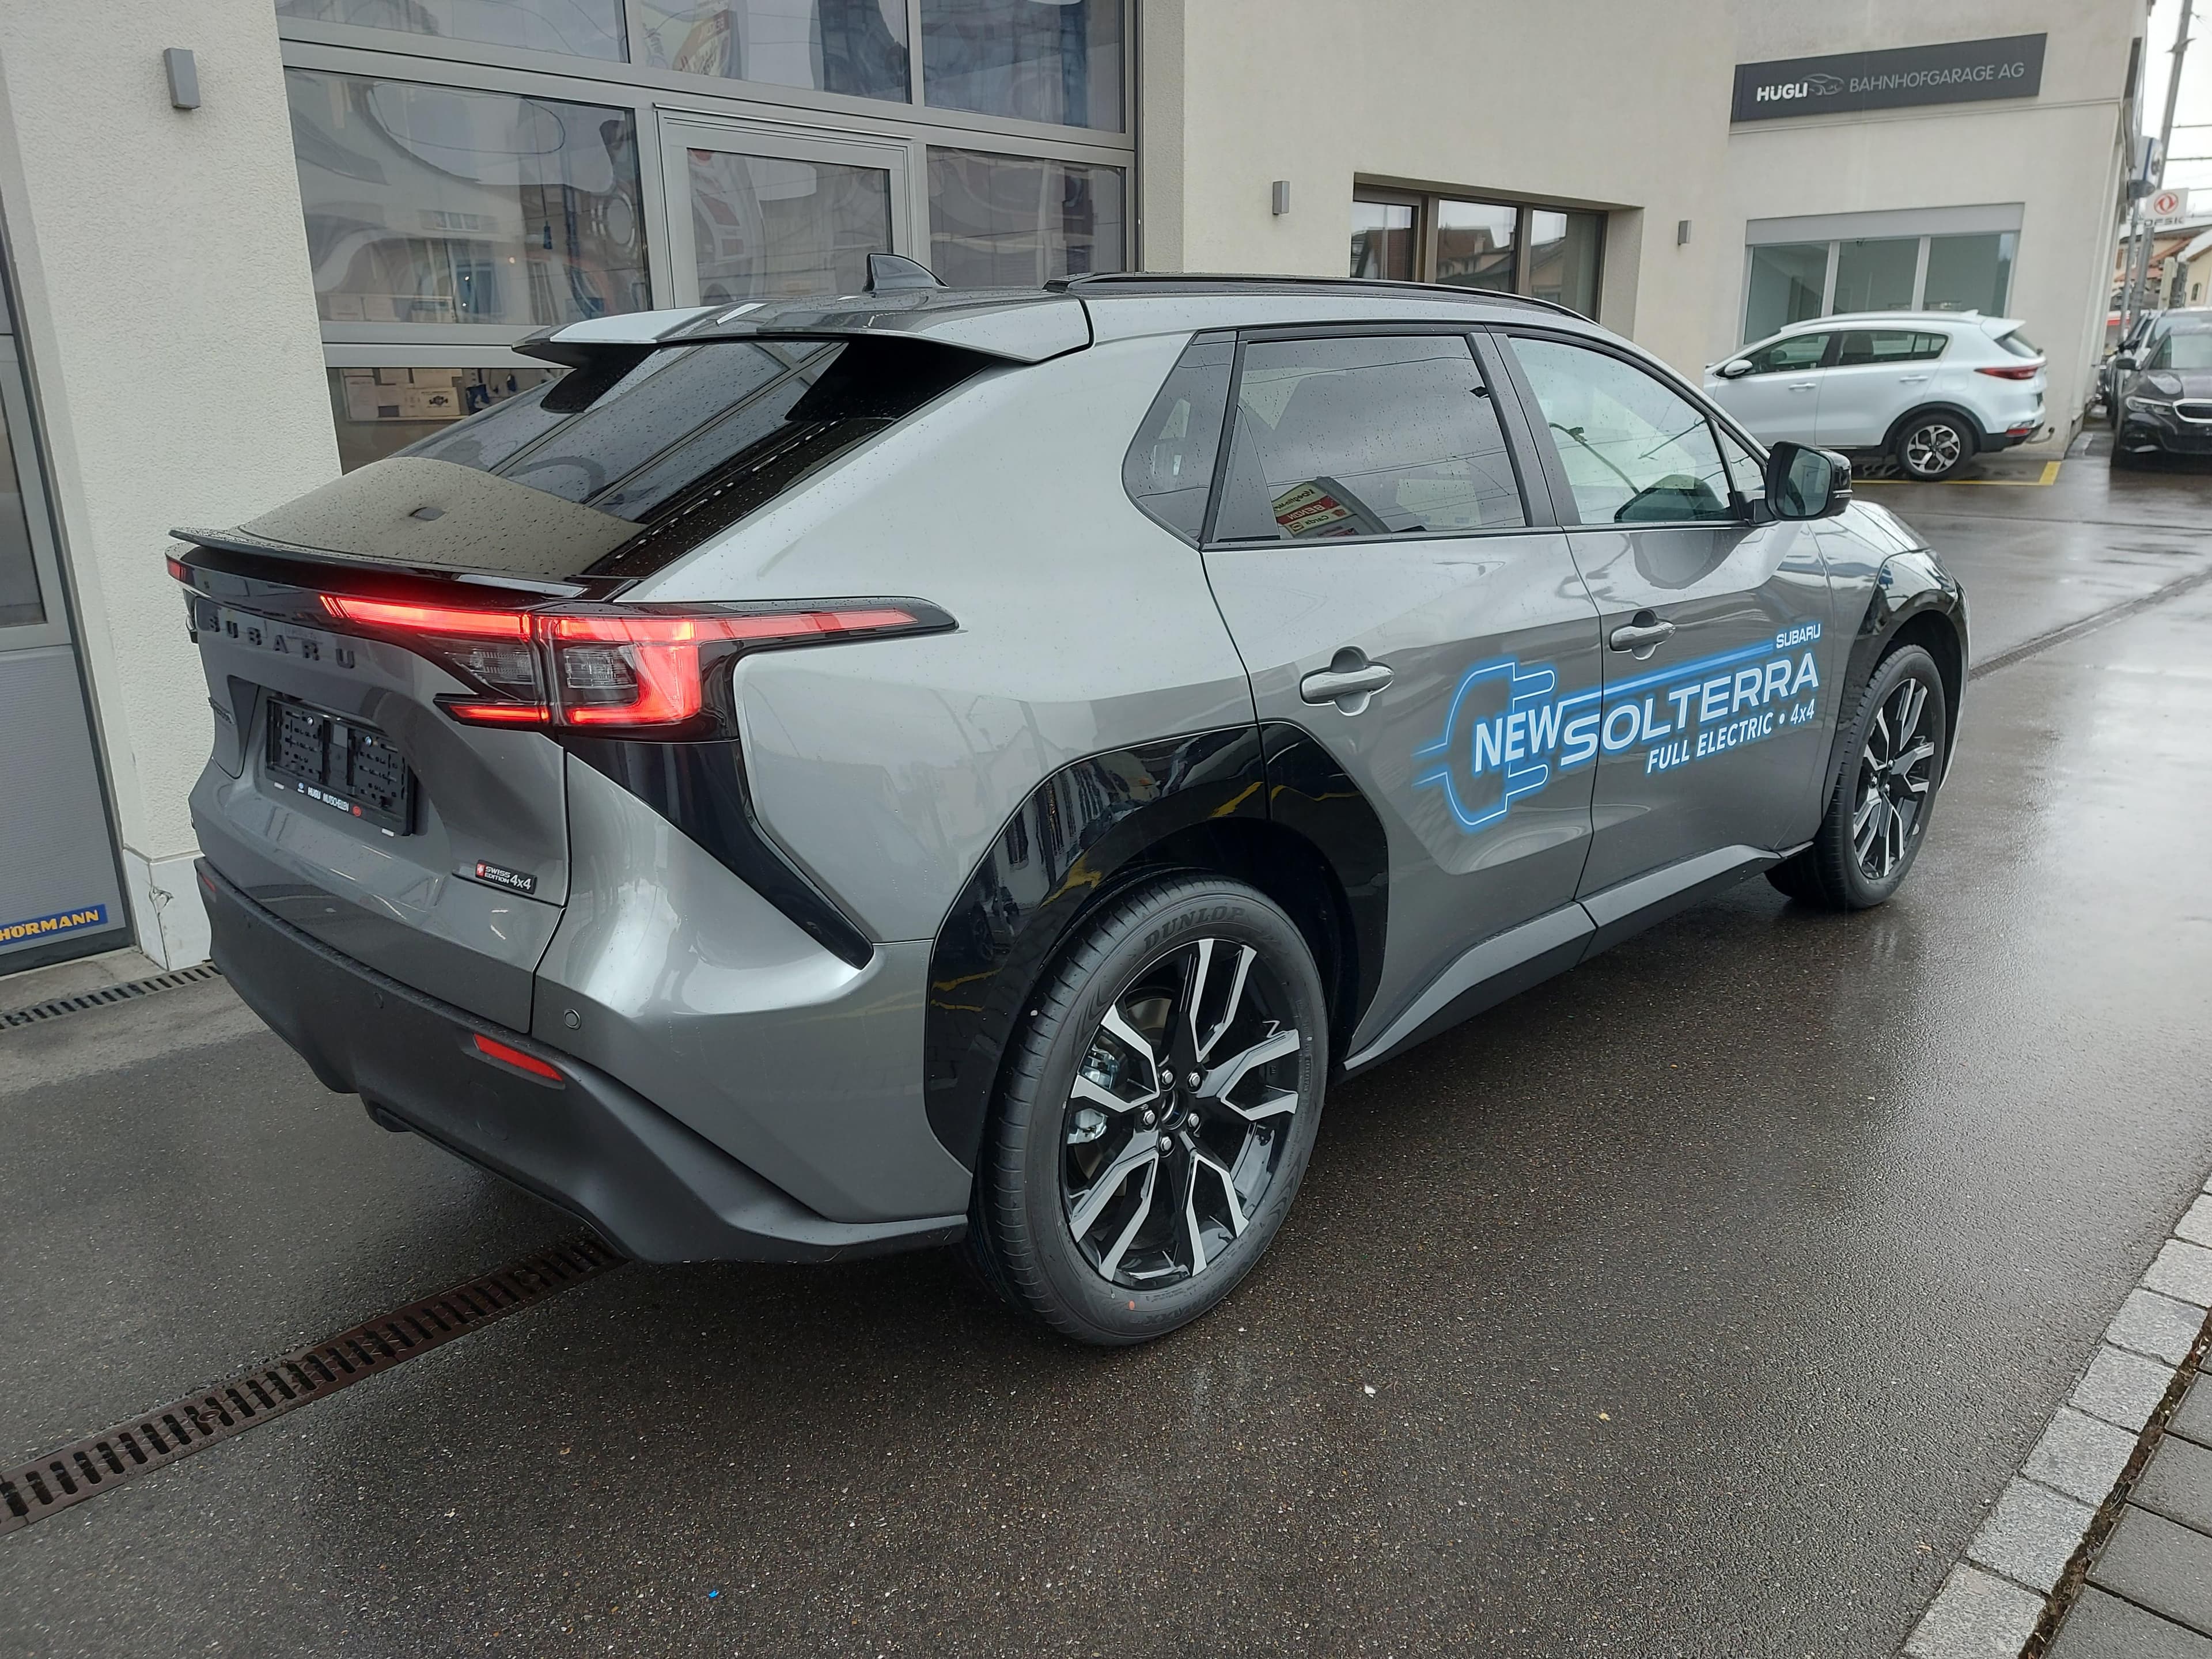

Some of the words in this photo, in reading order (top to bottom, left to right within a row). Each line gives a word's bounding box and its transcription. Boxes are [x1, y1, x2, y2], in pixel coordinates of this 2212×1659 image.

[1850, 65, 1995, 93] BAHNHOFGARAGE
[1998, 62, 2025, 79] AG
[208, 615, 355, 669] SUBARU
[1776, 623, 1821, 649] SUBARU
[1475, 702, 1564, 772] NEW
[1560, 652, 1819, 767] SOLTERRA
[1647, 740, 1690, 774] FULL
[1696, 712, 1774, 757] ELECTRIC
[1790, 698, 1815, 725] 4x4
[484, 872, 509, 884] EDITION
[485, 866, 511, 878] SWISS
[510, 874, 532, 890] 4x4
[0, 909, 99, 942] HÖRMANN
[1143, 906, 1246, 952] DUNLOP
